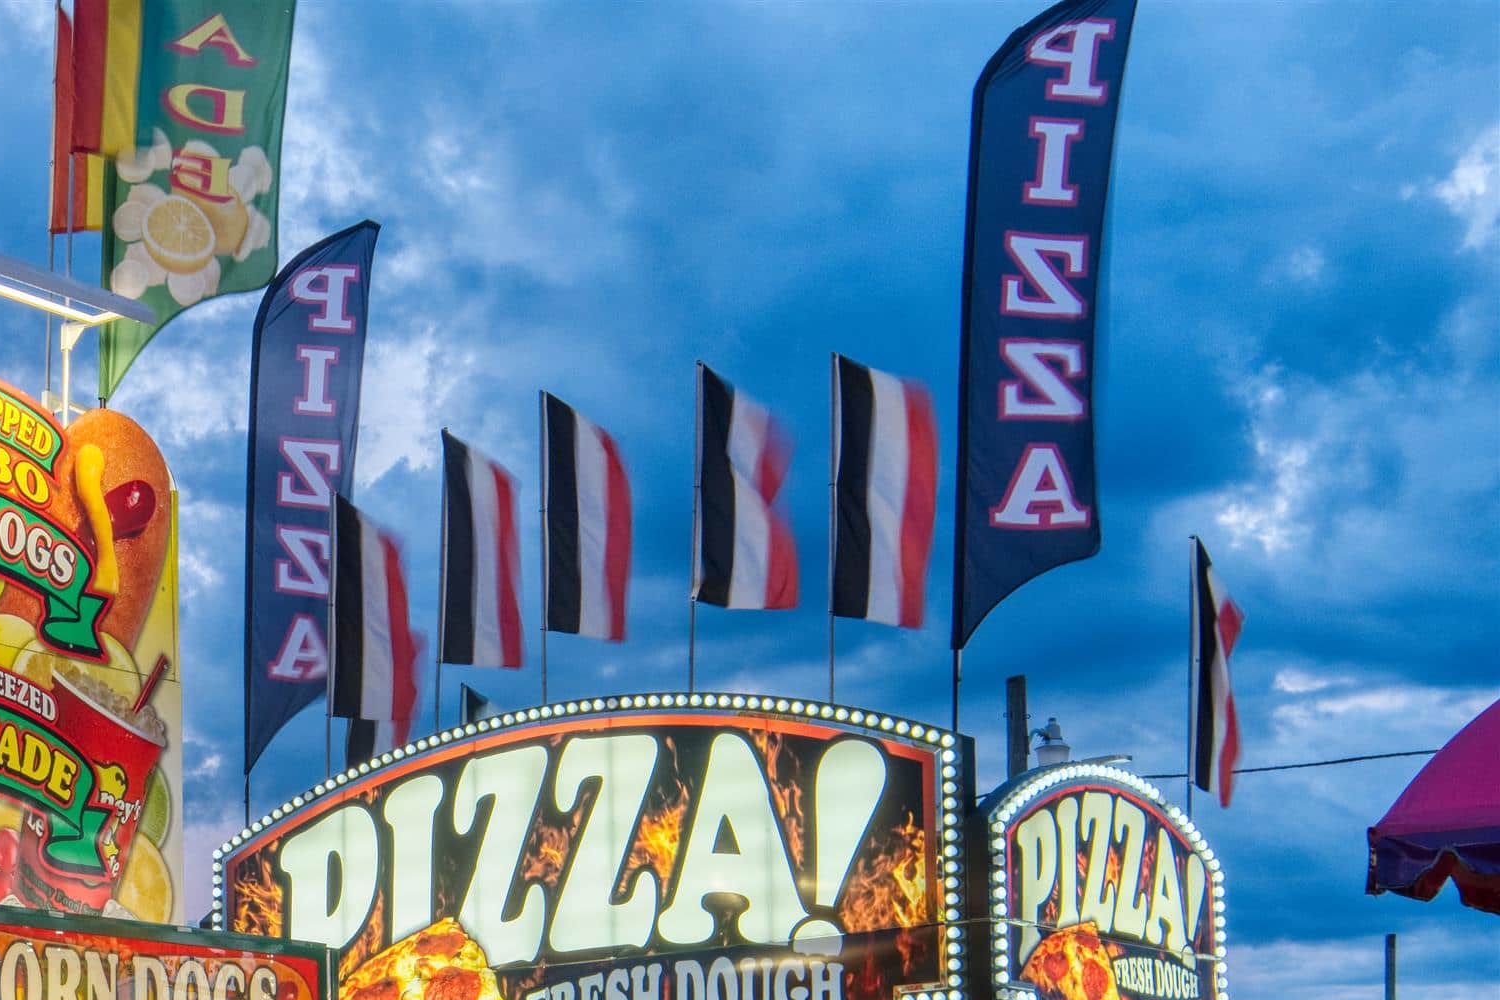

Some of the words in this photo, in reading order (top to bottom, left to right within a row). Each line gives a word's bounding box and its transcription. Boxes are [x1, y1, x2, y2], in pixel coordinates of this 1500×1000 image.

[279, 732, 887, 965] PIZZA!
[1015, 790, 1208, 970] PIZZA!
[1114, 957, 1155, 999] FRESH
[1156, 963, 1199, 1000] DOUGH
